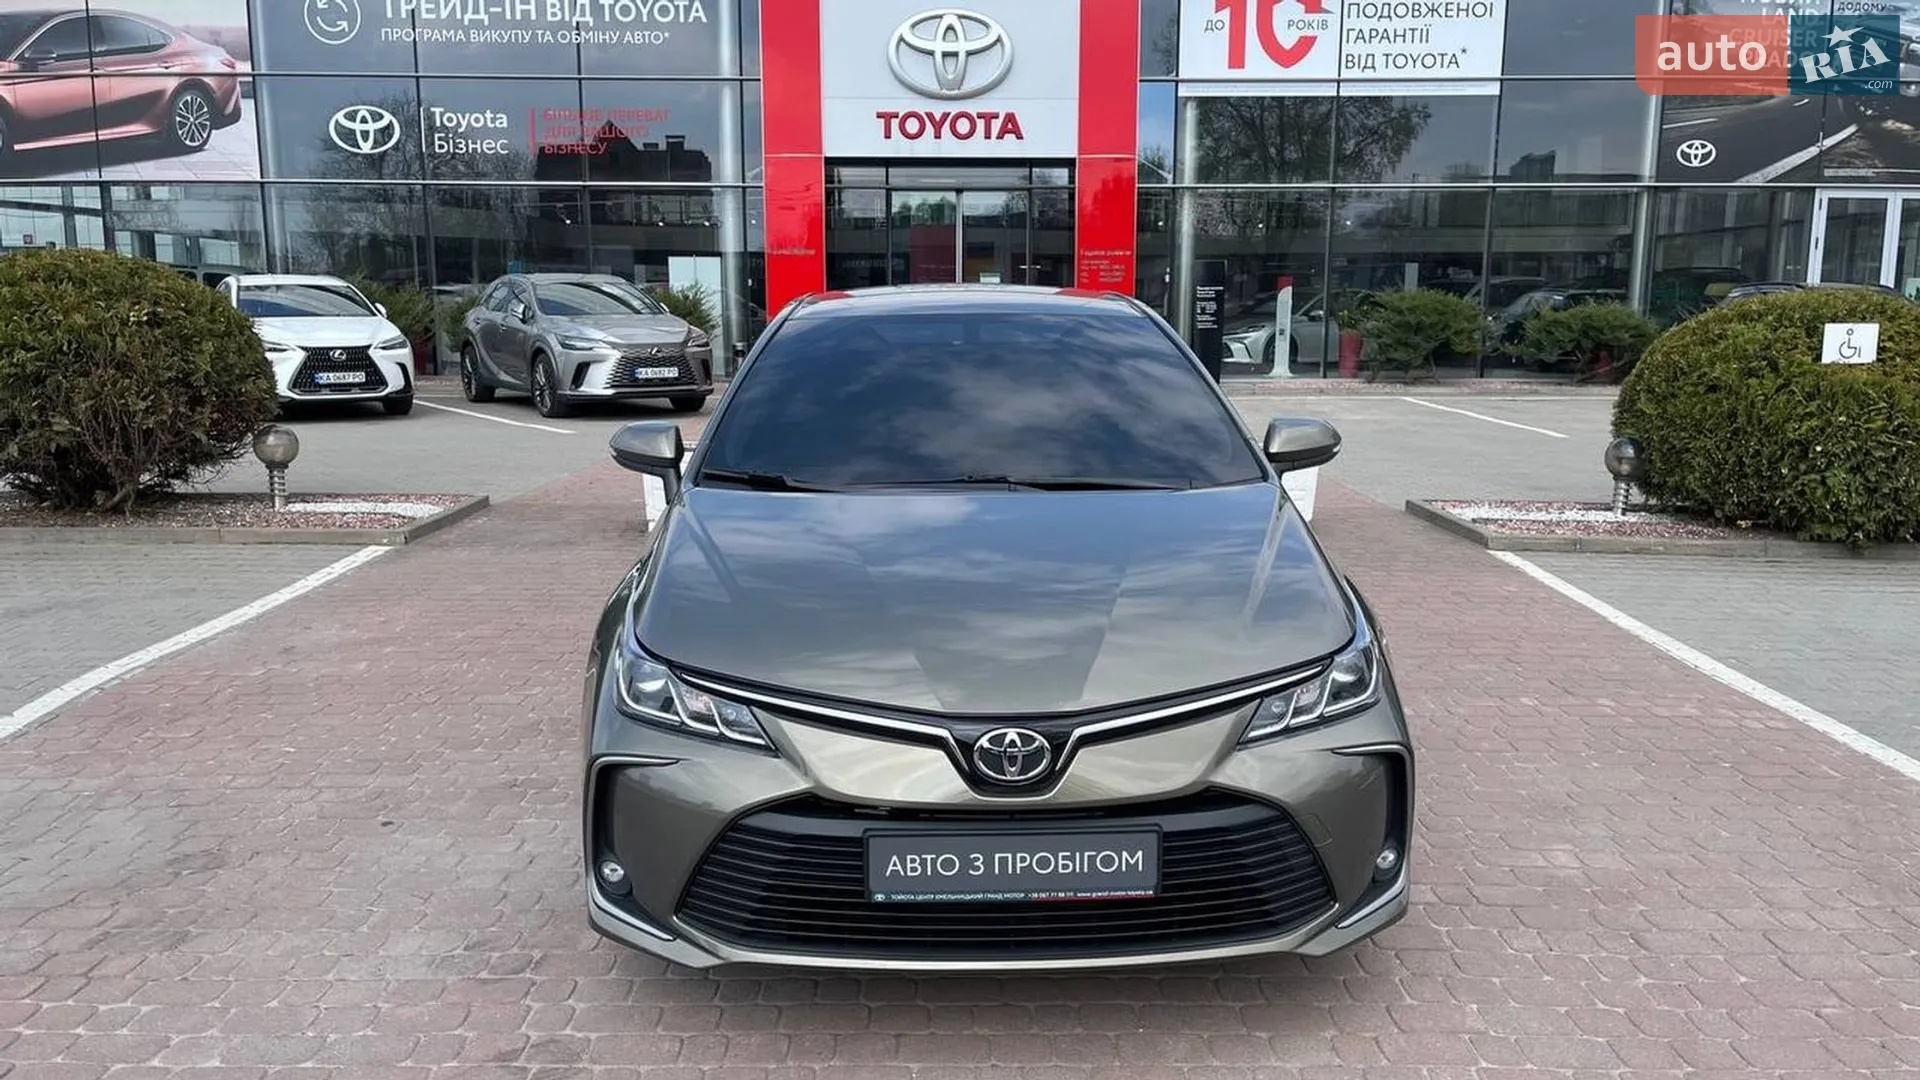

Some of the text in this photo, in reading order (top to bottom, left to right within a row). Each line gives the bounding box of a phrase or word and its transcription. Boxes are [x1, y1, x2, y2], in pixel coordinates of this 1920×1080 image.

[546, 0, 594, 27] ВІД
[599, 0, 708, 23] TOYOTA
[381, 28, 466, 42] ПРОГРАМА
[470, 29, 532, 43] ВИКУПУ
[536, 30, 554, 43] ТА
[557, 30, 620, 44] ОБМІНУ
[1204, 19, 1329, 33] ДО РОКІВ
[1346, 24, 1432, 44] ГАРАНТІЇ
[1345, 53, 1376, 72] ВІД
[430, 107, 508, 132] Toyota
[876, 111, 1024, 140] TOYOTA
[434, 134, 509, 155] Бізнес
[885, 853, 960, 876] АВТО
[994, 850, 1144, 875] ПРОБІГОМ
